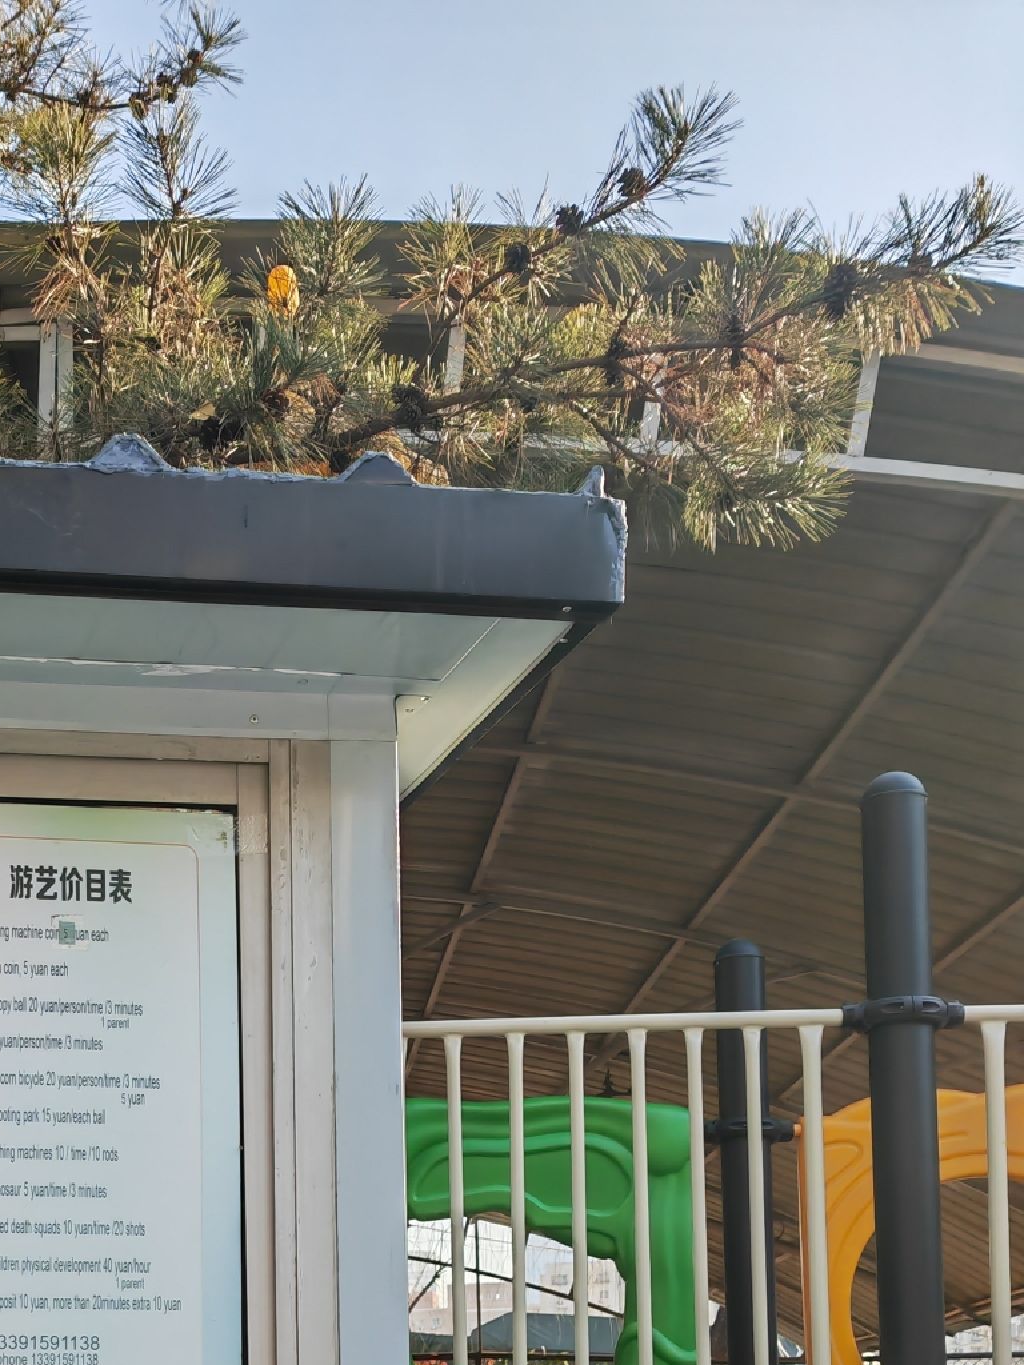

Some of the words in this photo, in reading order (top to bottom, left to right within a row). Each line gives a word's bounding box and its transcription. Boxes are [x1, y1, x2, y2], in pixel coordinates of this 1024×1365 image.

[12, 924, 43, 940] machine
[91, 927, 109, 941] each
[31, 1353, 99, 1365] 13391591138
